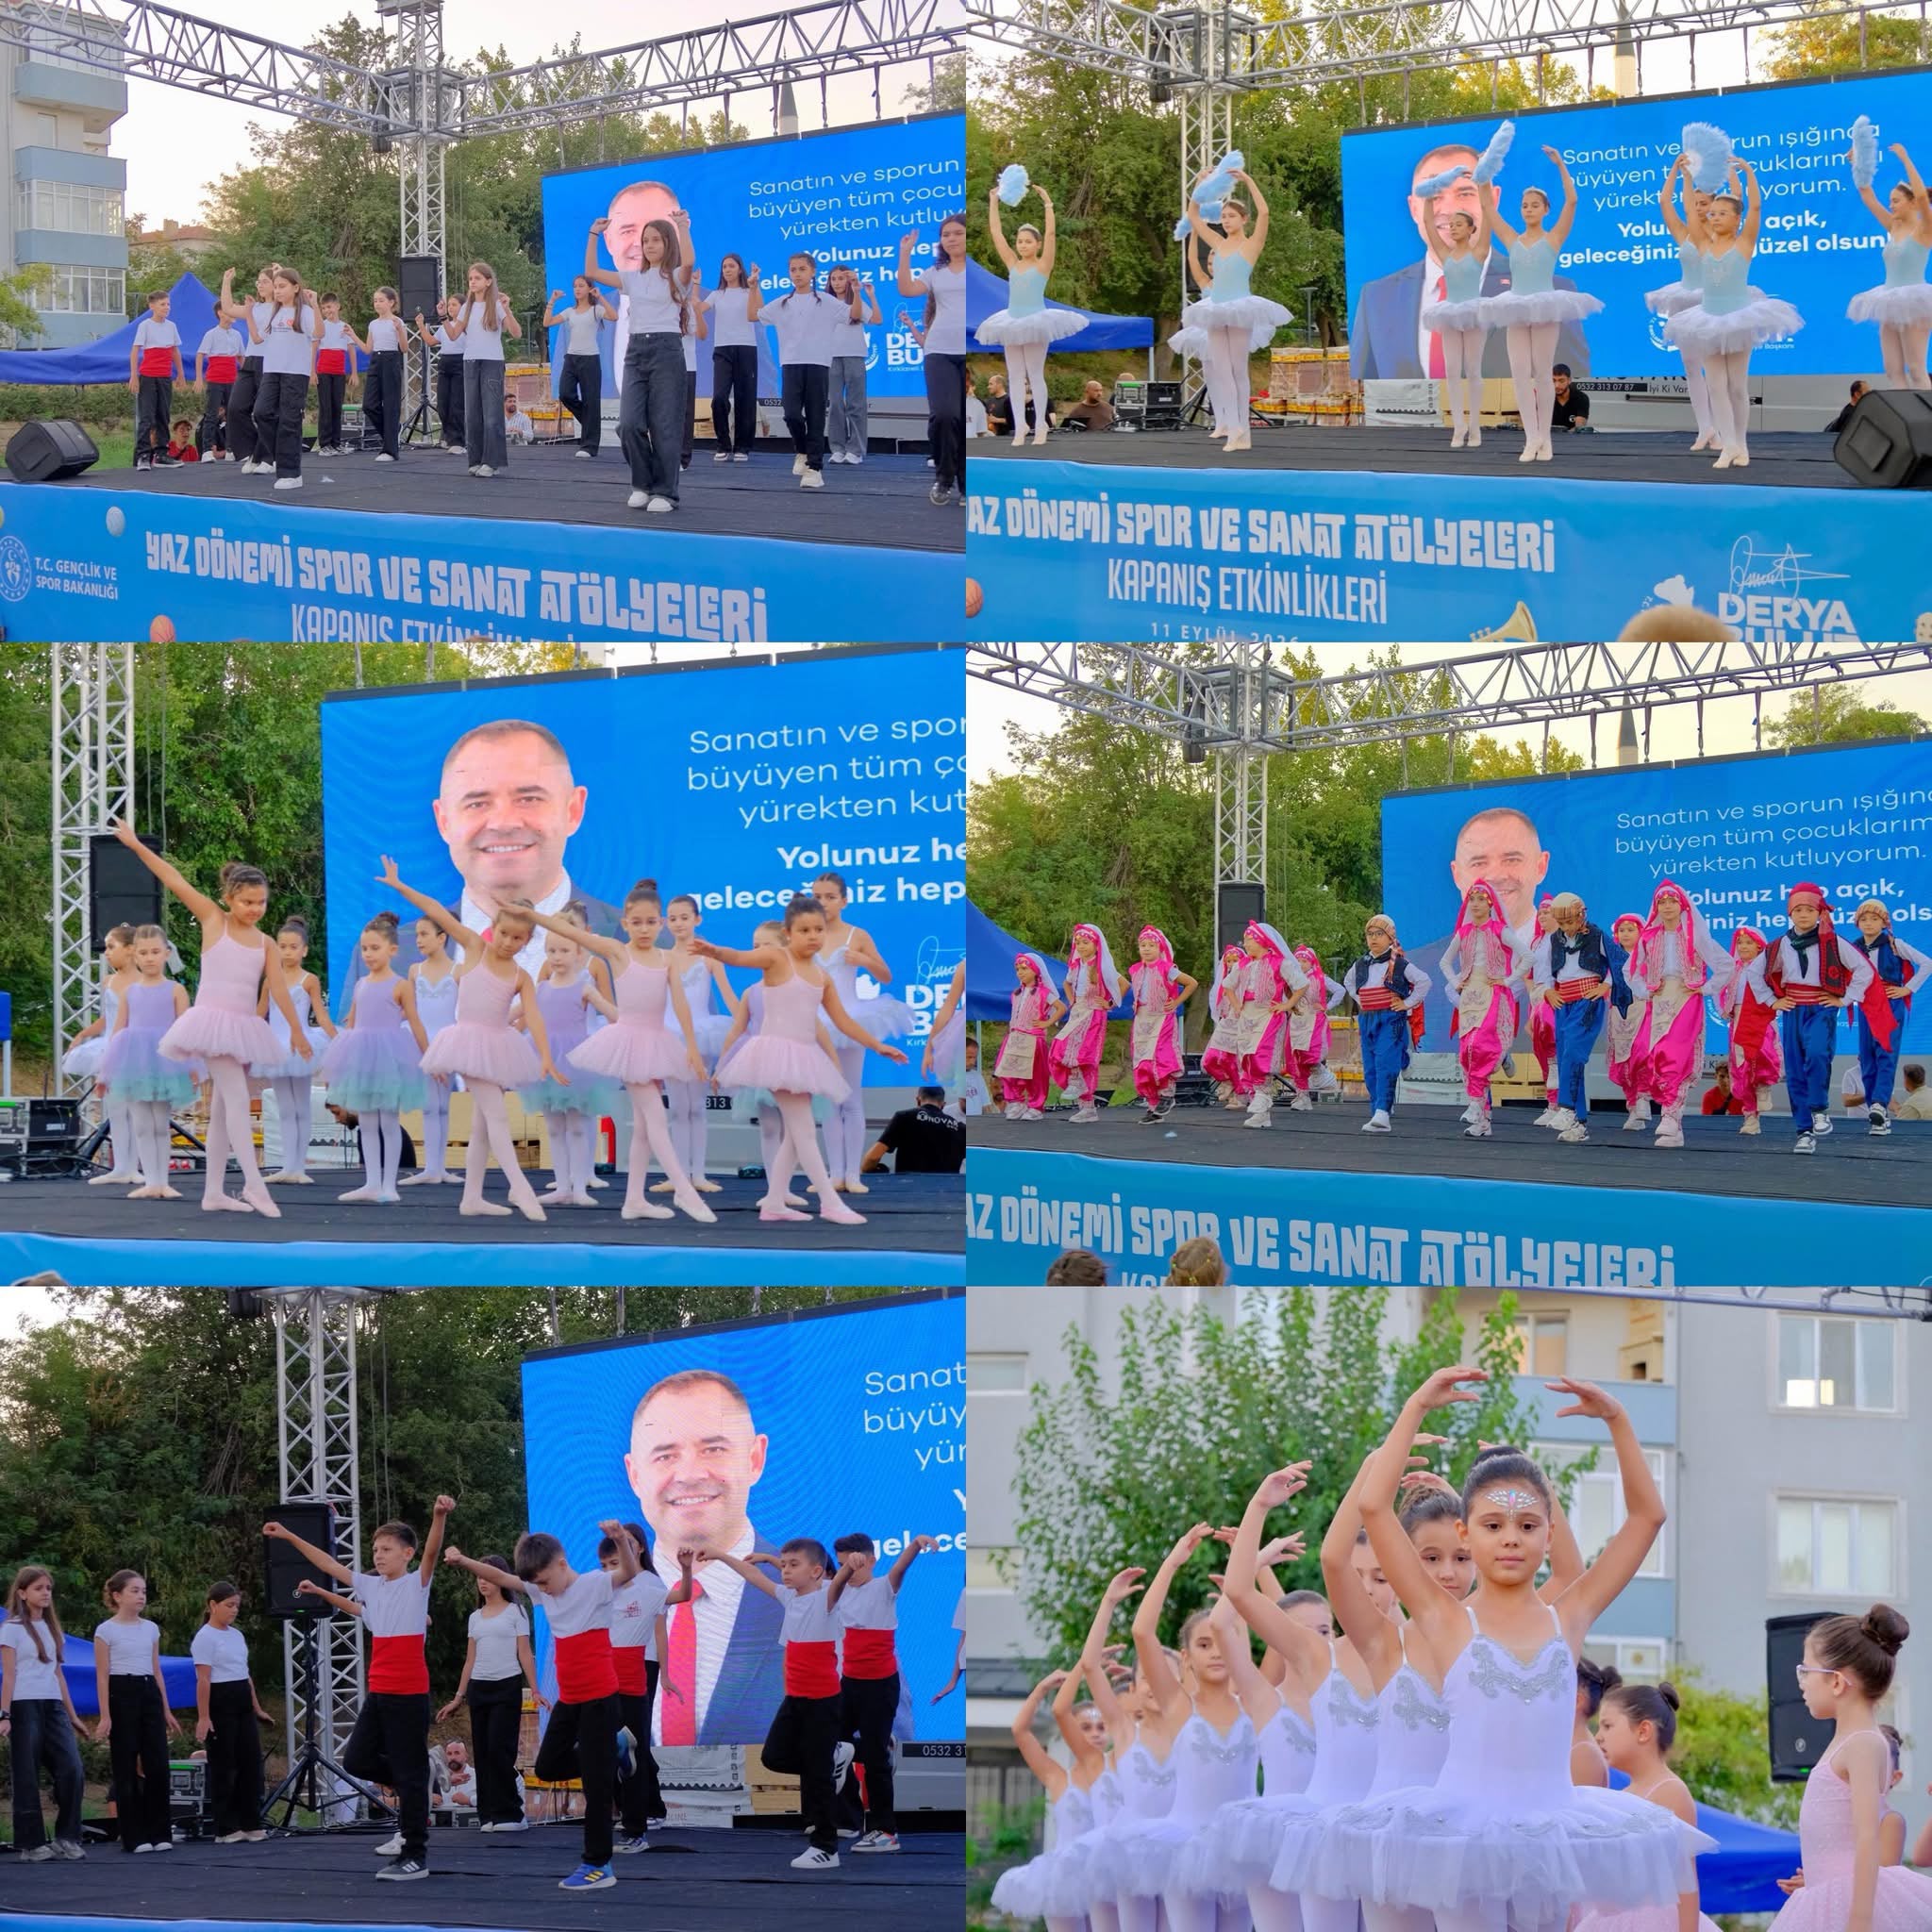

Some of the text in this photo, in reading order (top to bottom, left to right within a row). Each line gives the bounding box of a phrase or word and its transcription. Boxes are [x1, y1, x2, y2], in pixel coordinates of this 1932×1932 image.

[1562, 125, 1880, 165] Sanatın ve run ışığına
[750, 159, 959, 196] Sanatın ve sporun
[1570, 165, 1656, 188] üyüyen
[749, 179, 966, 218] büyüyen tüm çocu
[780, 206, 966, 240] yürekten kutlu
[1617, 220, 1672, 238] Yolu
[1764, 209, 1827, 231] açık,
[1558, 242, 1681, 268] geleceğiniz
[1751, 236, 1808, 258] üzel
[967, 489, 1555, 573] AZ DÖNEMİ SPOR VE SANAT ATÖLYELERİ
[35, 557, 118, 581] T.C. GENÇLİK VE
[146, 531, 191, 575] YAZ
[194, 527, 293, 589] DÖNEMİ
[297, 546, 375, 598] SPOR
[378, 556, 423, 605] VE
[427, 559, 531, 619] SANAT
[540, 569, 768, 642] ATÖLYELERİ
[36, 575, 119, 601] SPOR BAKANLIĞI
[1108, 558, 1388, 625] KAPANIŞ ETKİNLİKLERİ
[1151, 622, 1170, 637] 11
[1718, 591, 1857, 635] DERYA
[690, 717, 966, 754] Sanatın ve spor
[687, 761, 839, 793] büyüyen
[848, 755, 922, 780] tüm
[739, 789, 966, 830] yürekten kut
[1616, 808, 1709, 829] Sanatın
[1717, 807, 1744, 820] ve
[1752, 797, 1843, 820] sporun
[1616, 816, 1932, 855] büyüyen tüm çocuklarım
[776, 838, 966, 870] Yolunuz he
[1649, 845, 1927, 879] yürekten kutluyorum.
[896, 876, 966, 906] hep
[1686, 888, 1774, 906] olunuz
[1836, 878, 1906, 900] açık,
[1891, 903, 1932, 923] ols
[1001, 1185, 1124, 1255] DÖNEMİ
[1229, 1216, 1280, 1270] VE
[1290, 1220, 1409, 1283] SANAT
[1420, 1228, 1675, 1288] ATÖLYELERİ
[864, 1361, 966, 1396] Sanat
[864, 1401, 966, 1434] büyüy
[922, 1745, 952, 1757] 0532
